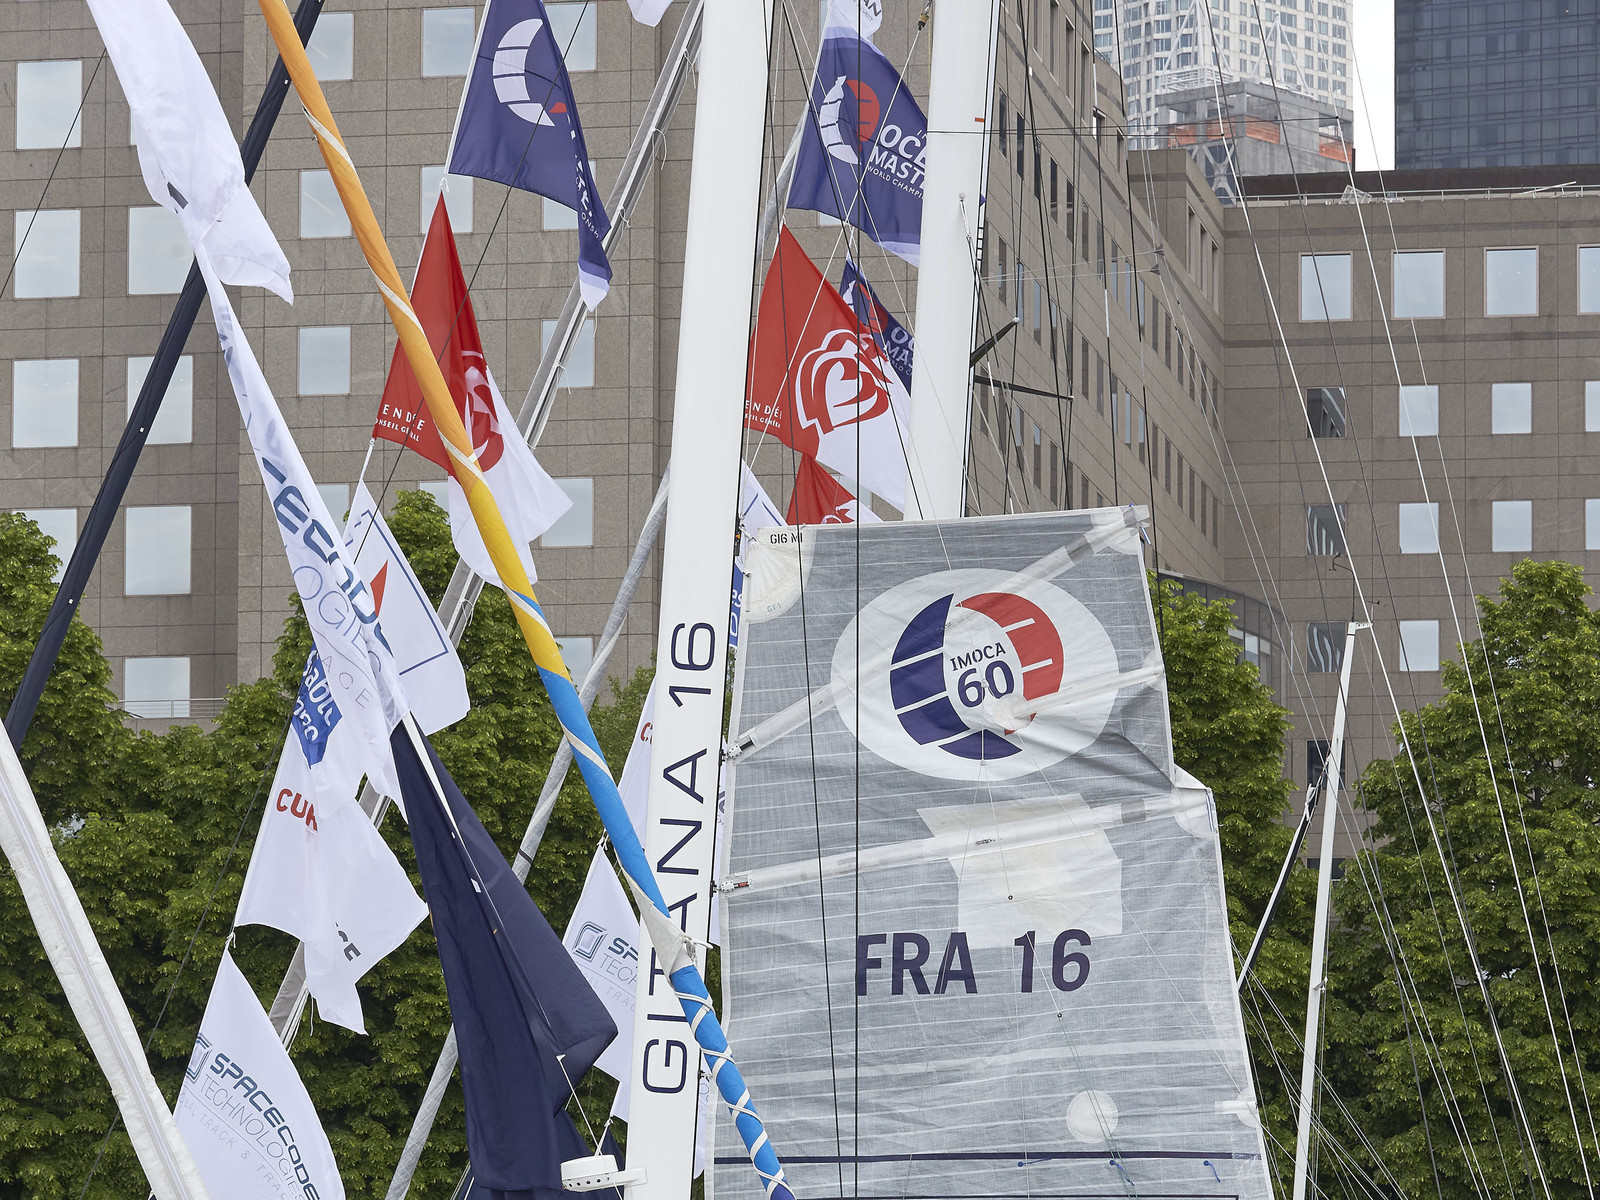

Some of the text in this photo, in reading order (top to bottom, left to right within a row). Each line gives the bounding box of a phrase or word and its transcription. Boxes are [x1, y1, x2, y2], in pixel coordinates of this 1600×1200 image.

[870, 146, 924, 190] MAST
[668, 622, 716, 708] 16
[950, 642, 1006, 672] IMOCA
[957, 660, 1015, 708] 60
[857, 928, 1092, 997] FRA 16
